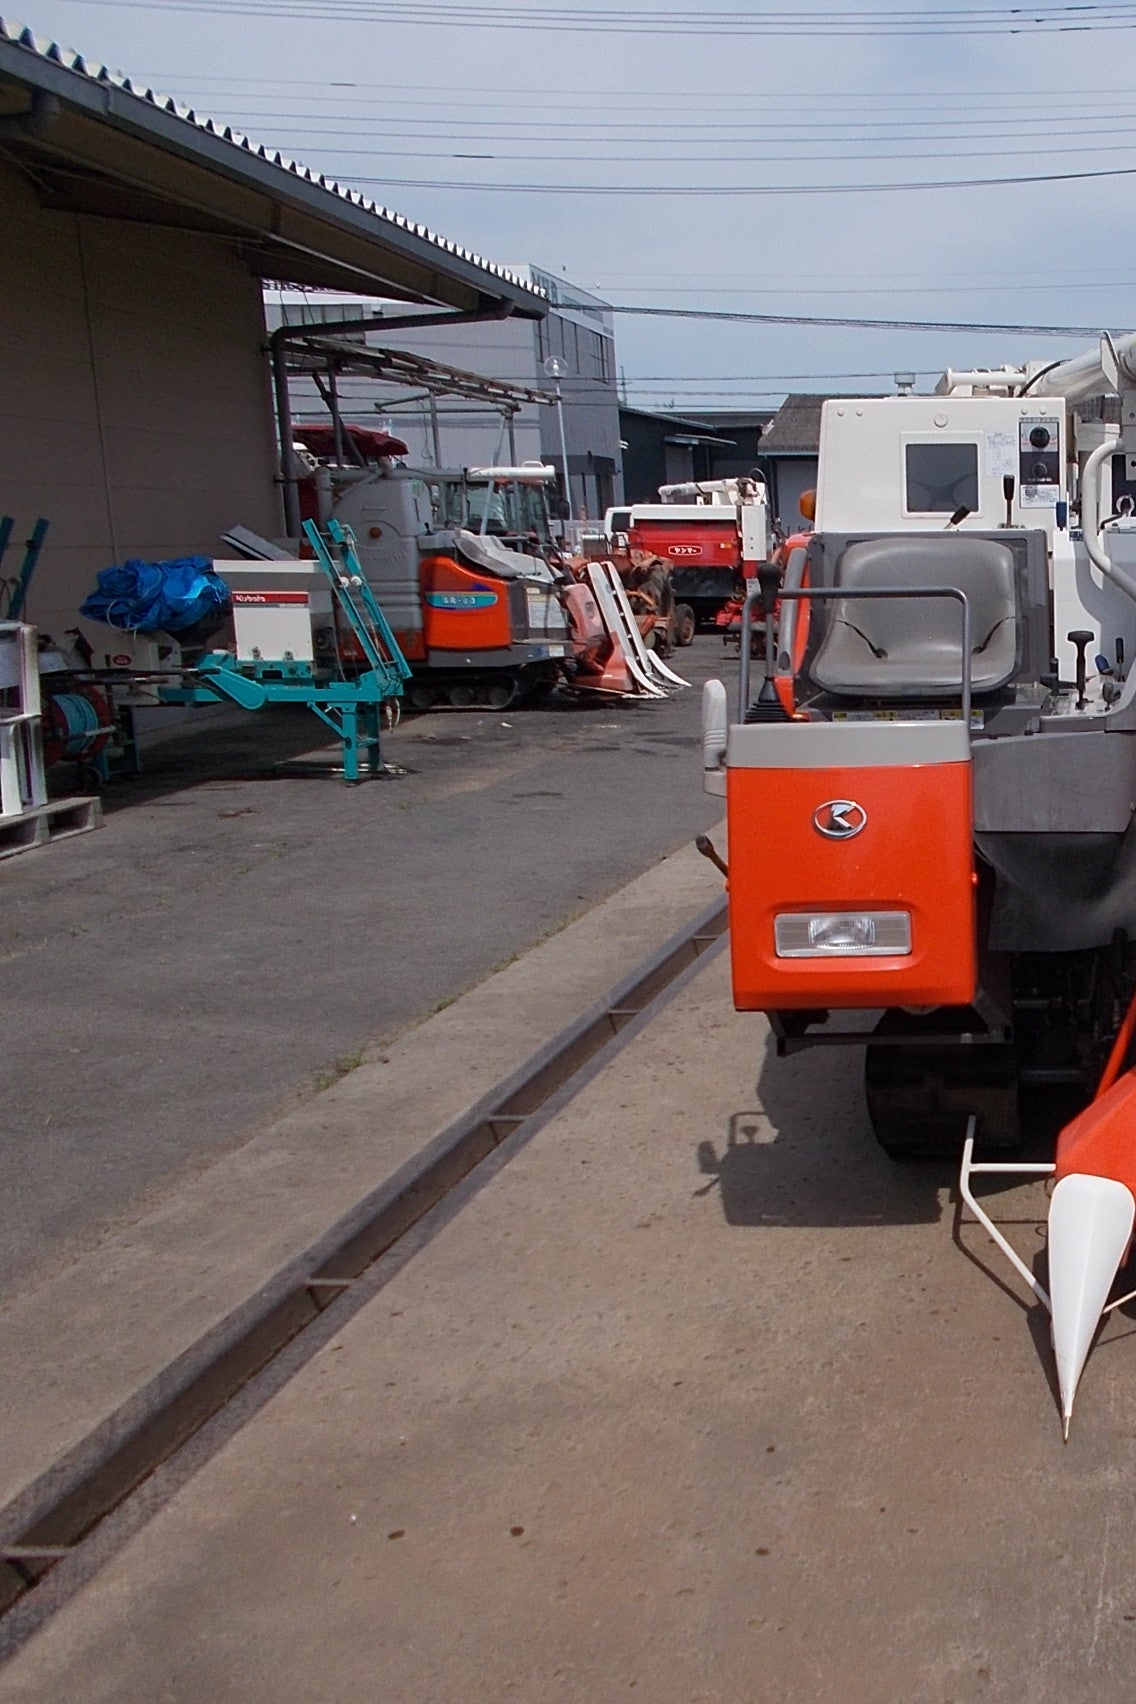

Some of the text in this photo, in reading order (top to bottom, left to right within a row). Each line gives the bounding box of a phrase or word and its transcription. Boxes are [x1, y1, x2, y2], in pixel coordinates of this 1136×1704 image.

[674, 547, 698, 555] ヤンマー
[235, 594, 266, 603] Kubota
